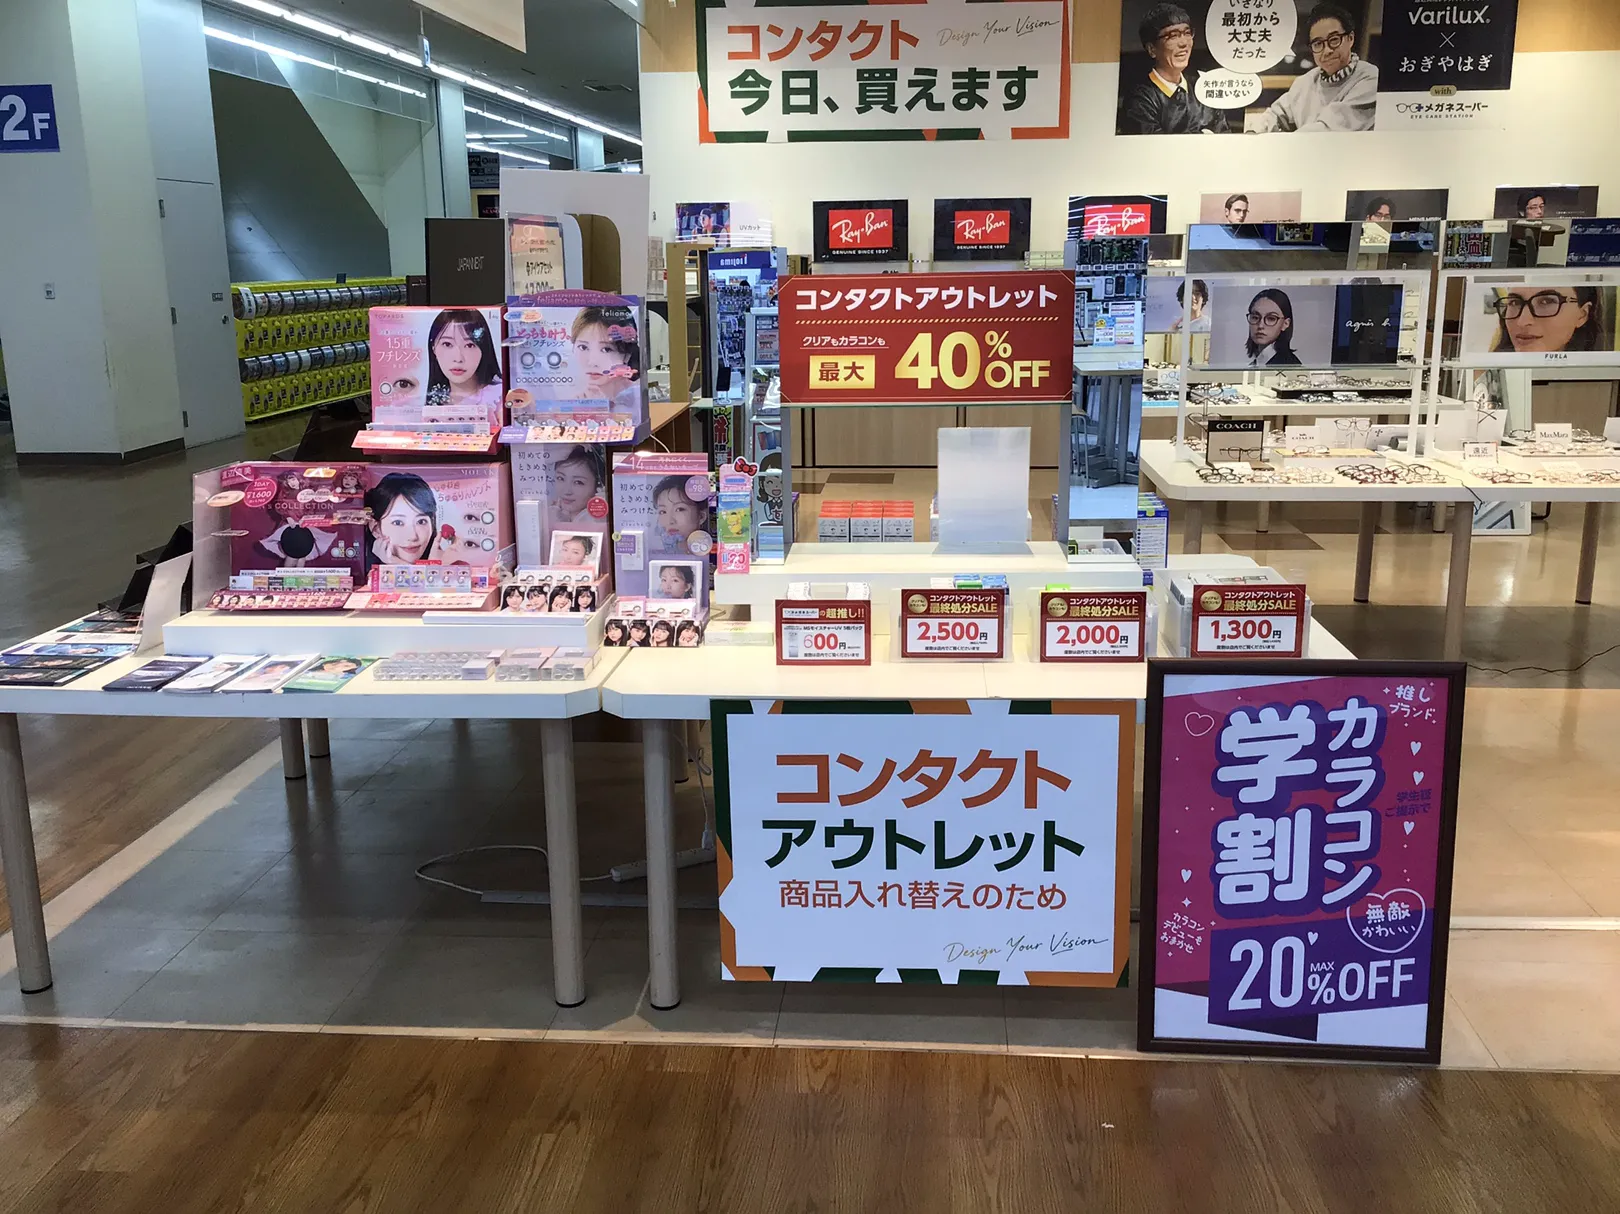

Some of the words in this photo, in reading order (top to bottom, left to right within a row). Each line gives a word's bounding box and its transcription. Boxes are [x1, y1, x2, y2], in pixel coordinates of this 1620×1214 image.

[1222, 11, 1280, 26] 最初から
[937, 28, 980, 47] Design
[982, 19, 1012, 43] Your
[1015, 16, 1061, 37] Vision
[1228, 28, 1272, 43] 大丈夫
[727, 19, 920, 62] コンタクト
[1232, 47, 1267, 59] だった
[1399, 54, 1493, 73] おぎやはぎ
[728, 65, 1039, 116] 今日、買えます
[1203, 79, 1254, 88] 矢作が言うなら
[1434, 86, 1452, 95] with
[1205, 89, 1251, 99] 間違いない
[1425, 102, 1489, 112] メガネスーパー
[0, 94, 51, 141] 2F
[739, 224, 761, 232] UVカット
[795, 285, 1058, 311] コンタクトアウトレット
[803, 335, 886, 347] クリアもカラコンも
[376, 350, 421, 362] フチレンズ
[818, 361, 865, 382] 最大
[1539, 431, 1569, 439] MaxMara
[518, 451, 551, 460] 初めての
[518, 463, 552, 471] ときめき、
[620, 483, 653, 492] 初めての
[620, 495, 653, 503] ときめき、
[930, 594, 997, 603] コンタクトアウトレット
[1069, 597, 1138, 605] コンタクトアウトレット
[1224, 591, 1296, 599] コンタクトアウトレット
[930, 602, 998, 614] 最終処分SALE
[1069, 605, 1139, 617] 最終処分SALE
[1223, 599, 1296, 611] 最終処分SALE
[916, 621, 988, 643] 2,500円
[1056, 624, 1128, 646] 2,000円
[1210, 619, 1282, 642] 1,300円
[803, 632, 847, 651] 600円
[1395, 684, 1431, 703] 推し
[1389, 702, 1436, 720] ブランド
[776, 748, 1072, 810] コンタクト
[1322, 697, 1379, 905] カラコン
[1396, 788, 1433, 803] 学生証
[1215, 704, 1318, 906] 学割
[1384, 802, 1431, 818] ご提示で
[761, 818, 1085, 873] アウトレット
[778, 879, 1067, 910] 商品入れ替えのため
[1366, 900, 1411, 924] 無敵
[1173, 912, 1205, 931] カラコン
[1163, 920, 1203, 946] デビューも
[1362, 924, 1416, 939] かわいい
[943, 941, 1001, 964] Design
[1005, 937, 1043, 962] Your
[1049, 931, 1109, 955] Vision
[1160, 931, 1194, 954] おまかせ
[1310, 961, 1335, 972] MAX
